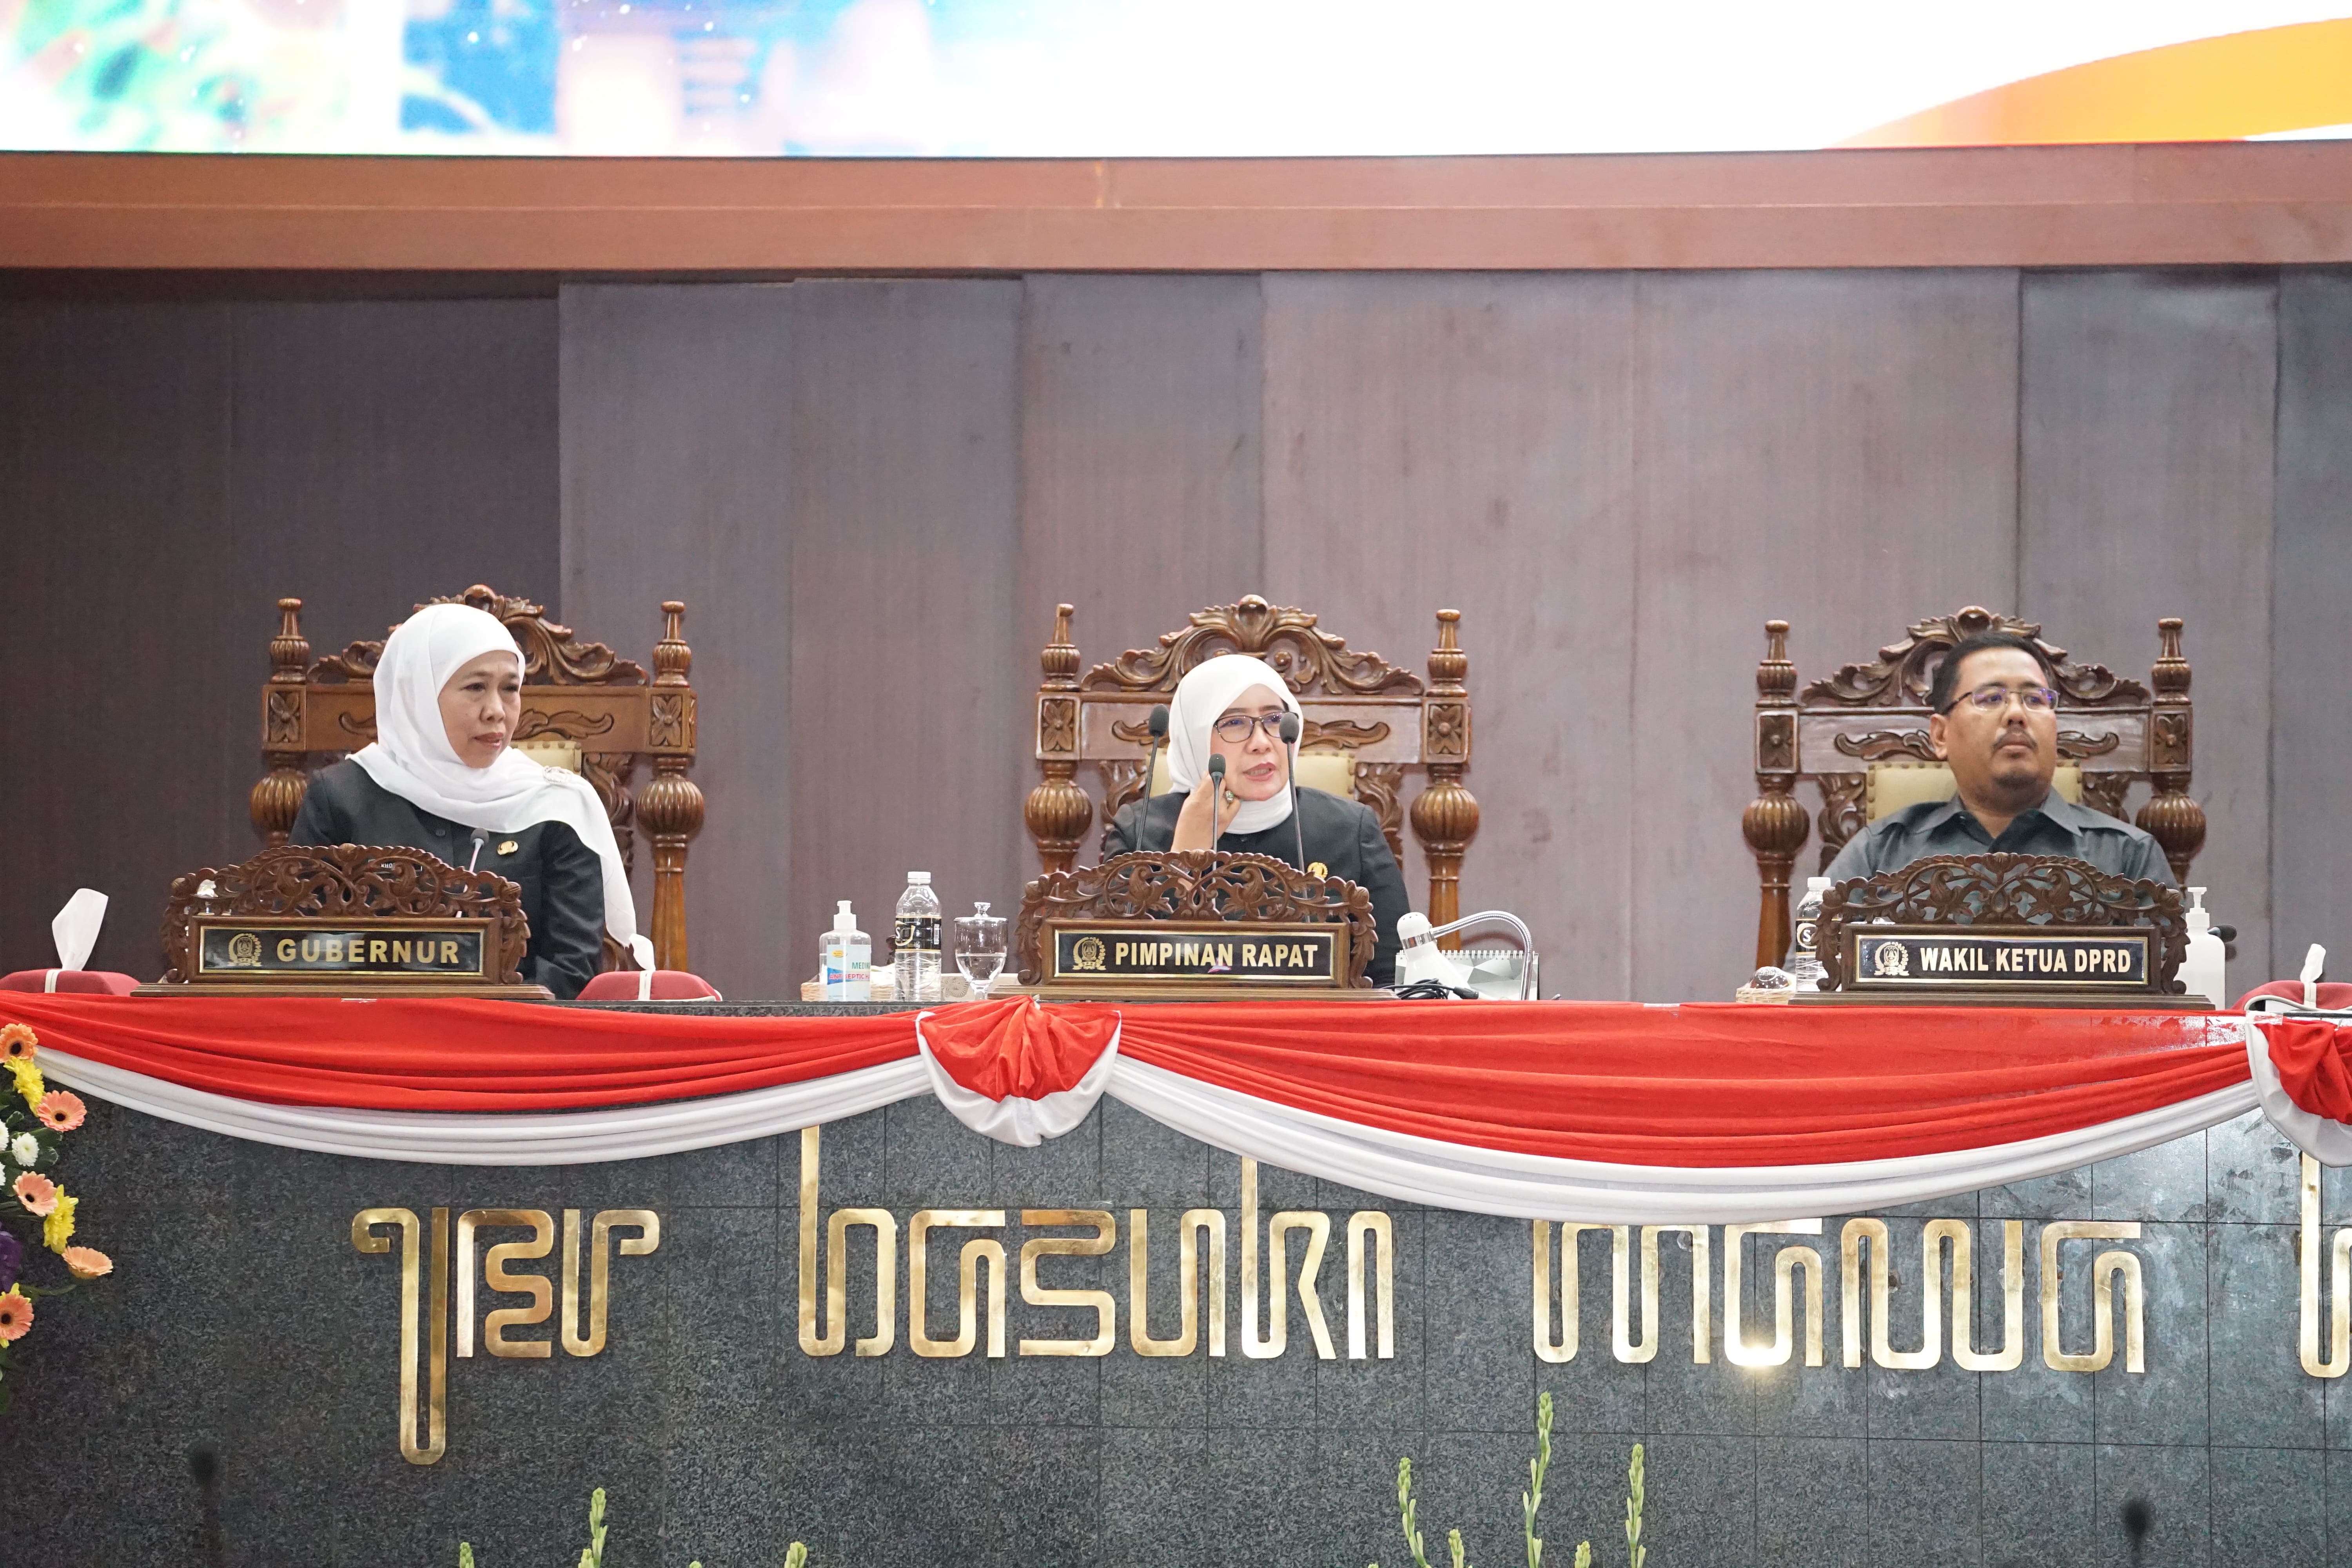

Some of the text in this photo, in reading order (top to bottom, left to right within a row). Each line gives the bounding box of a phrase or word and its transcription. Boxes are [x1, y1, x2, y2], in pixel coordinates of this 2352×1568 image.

[277, 938, 459, 964] GUBERNUR
[1115, 942, 1318, 967] PIMPINAN RAPAT
[1920, 947, 2131, 973] WAKIL KETUA DPRD
